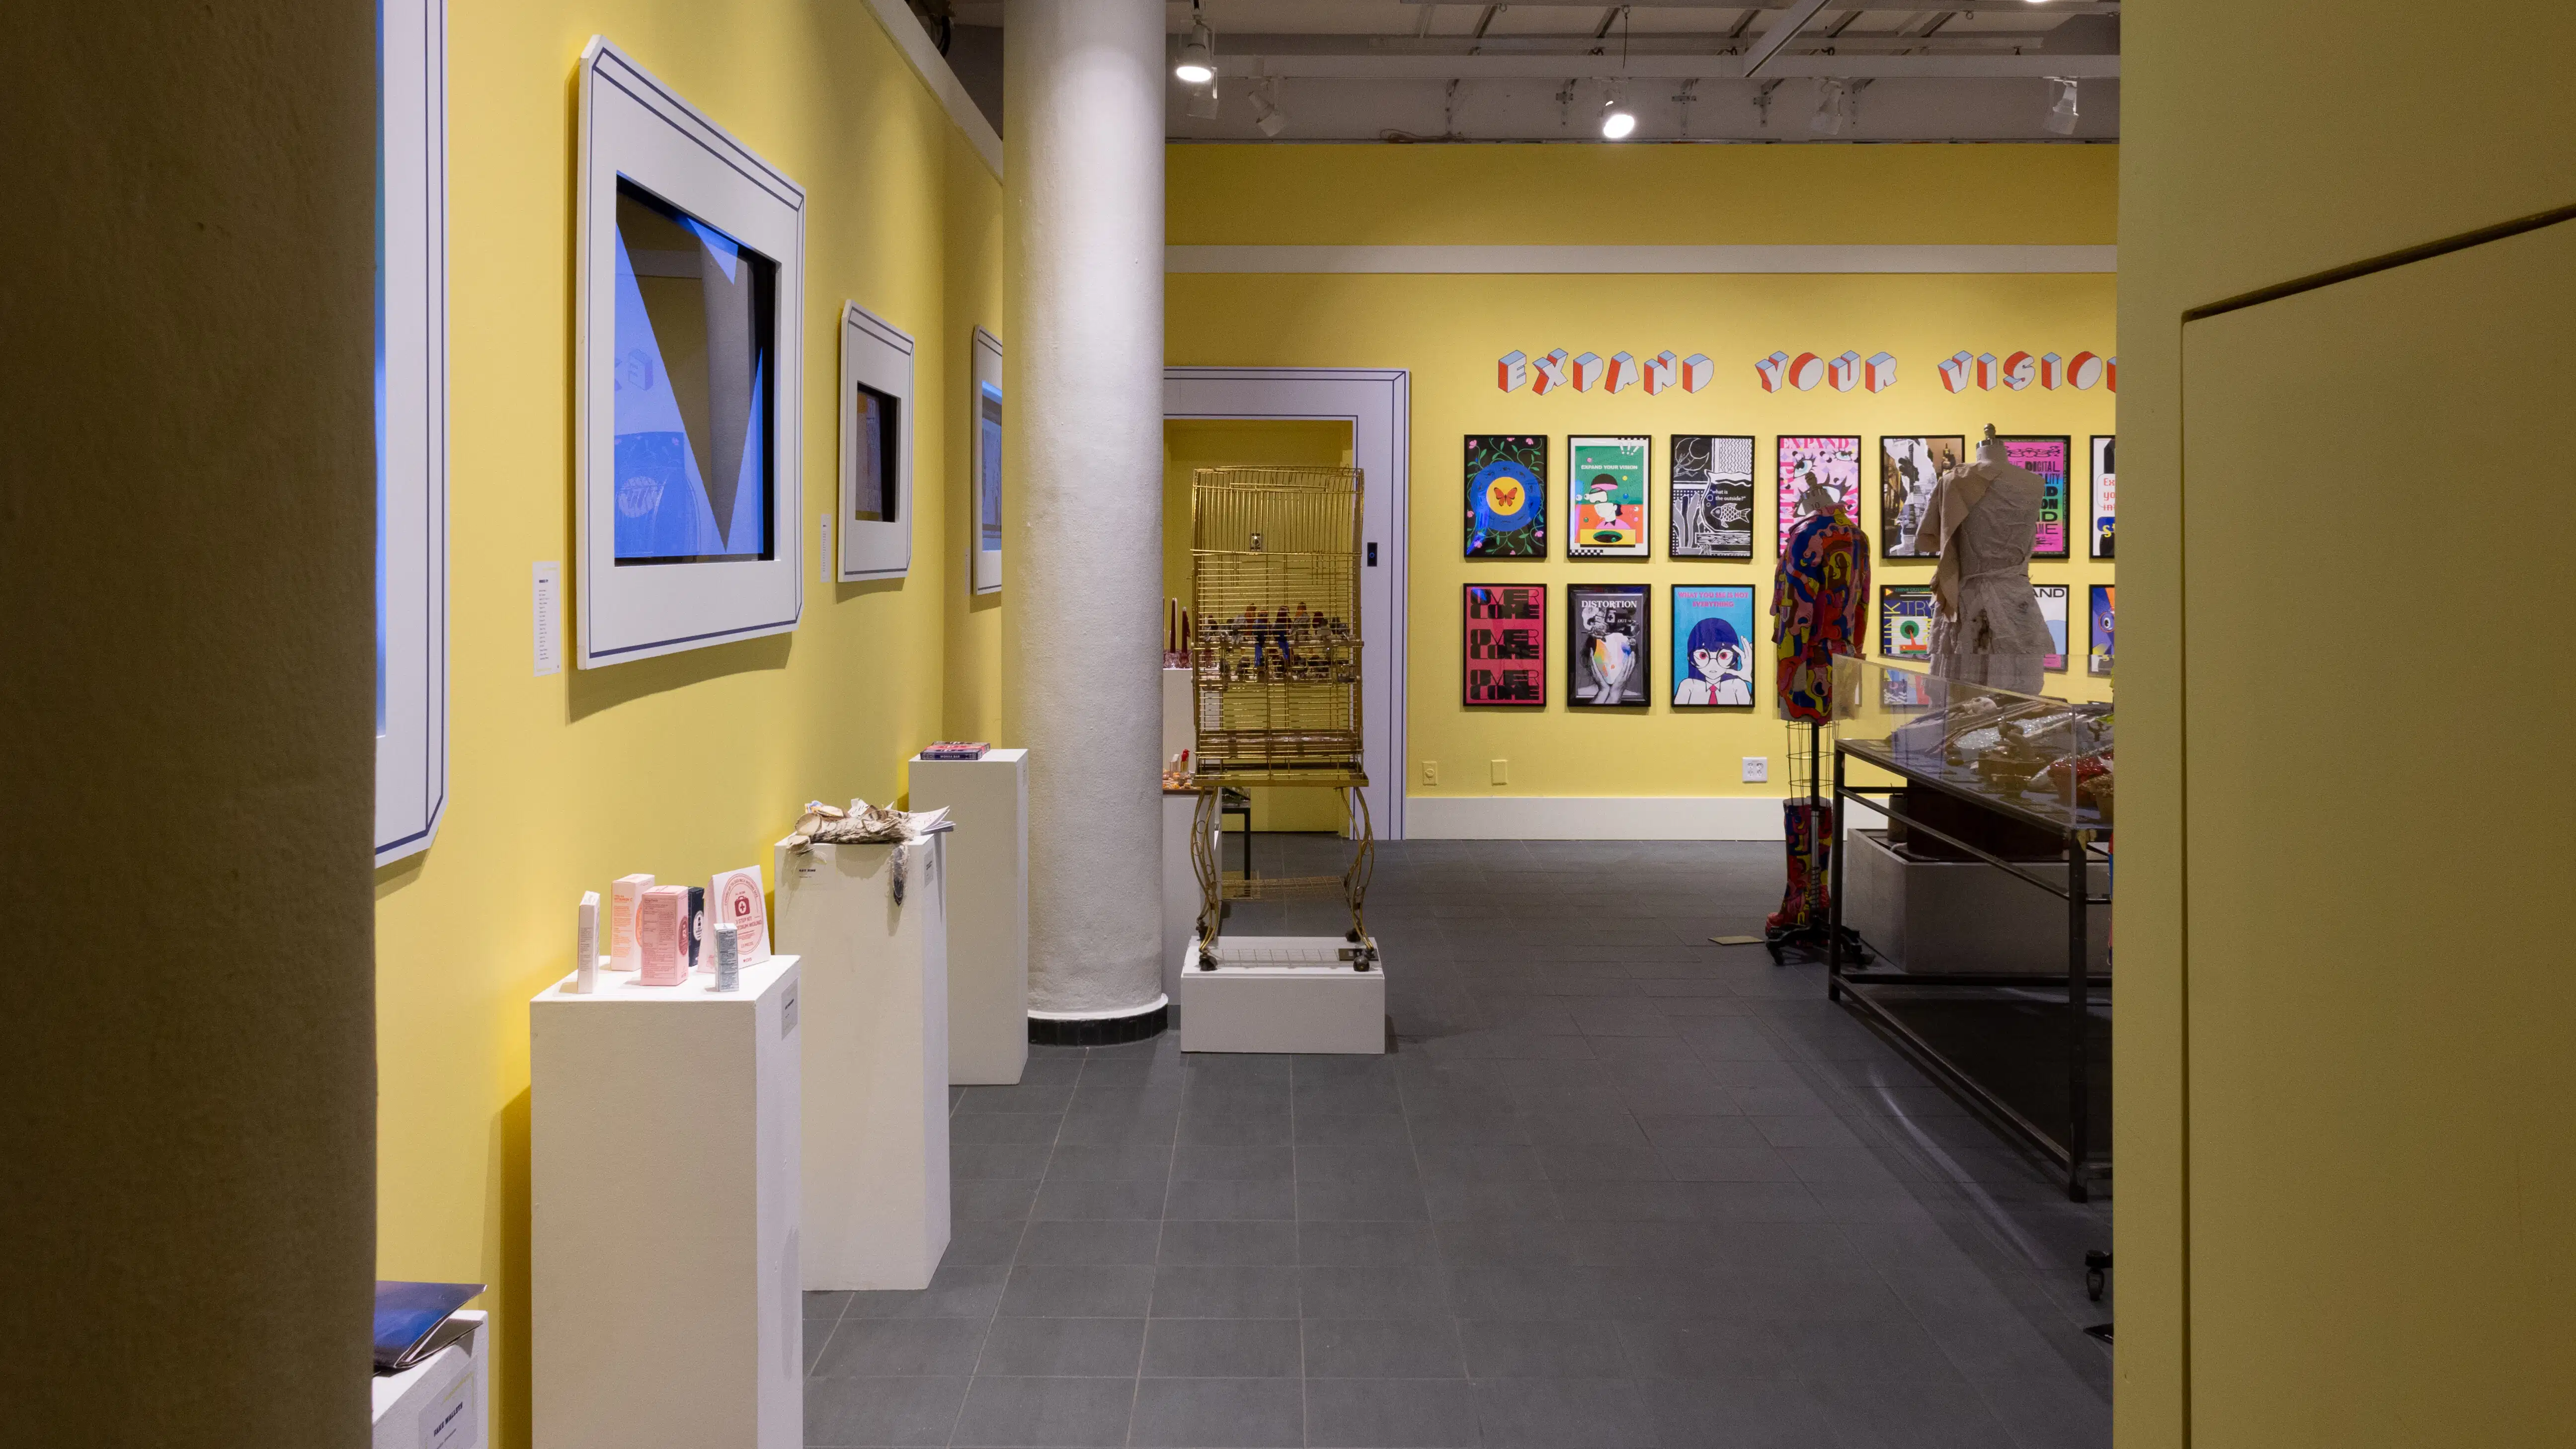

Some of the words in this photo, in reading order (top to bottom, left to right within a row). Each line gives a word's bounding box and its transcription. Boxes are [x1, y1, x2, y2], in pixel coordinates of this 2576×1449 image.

[1498, 348, 1714, 396] EXPAND
[1755, 350, 1897, 394] YOUR
[1938, 350, 2116, 394] VISIO
[2025, 461, 2060, 472] DIGITAL
[2039, 474, 2060, 484] LITY
[1470, 629, 1539, 645] OVER
[1470, 670, 1539, 686] OVER
